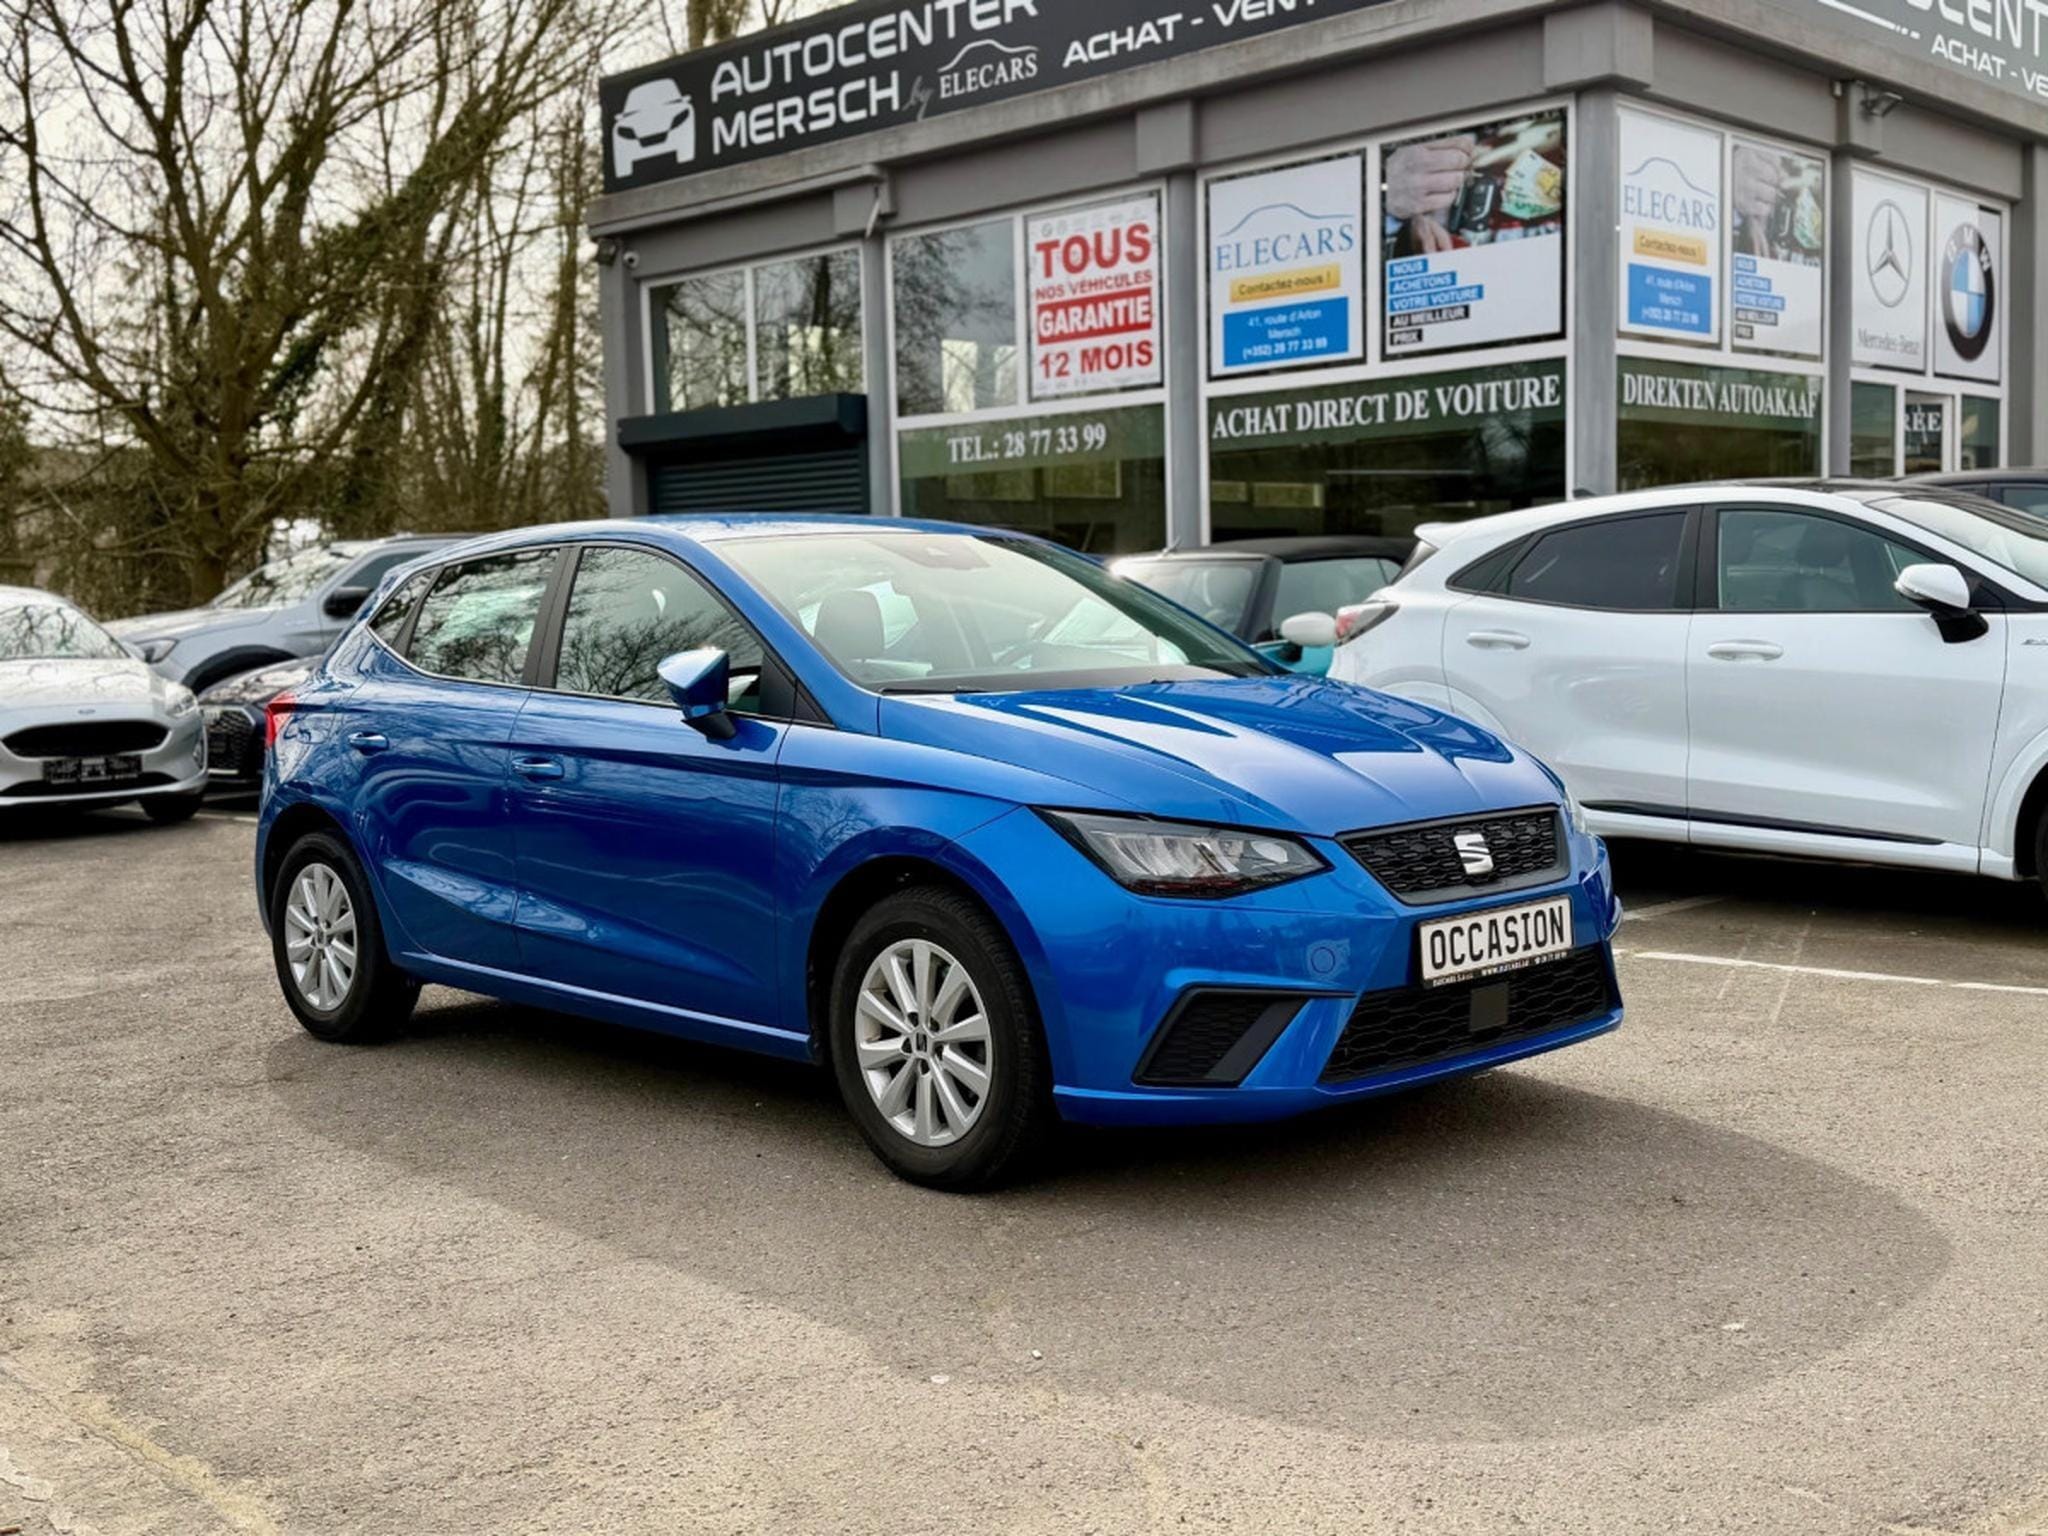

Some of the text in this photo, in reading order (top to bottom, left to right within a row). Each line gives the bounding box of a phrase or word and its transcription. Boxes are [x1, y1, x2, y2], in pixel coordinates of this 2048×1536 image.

[711, 0, 1039, 102] AUTOCENTER
[1063, 13, 1183, 68] ACHAT
[1211, 0, 1314, 27] VEN
[1906, 0, 2048, 57] CENT
[1931, 34, 2006, 79] ACHAT
[713, 71, 900, 155] MERSCH
[940, 53, 1038, 99] ELECARS
[1624, 185, 1716, 231] ELECARS
[1035, 223, 1152, 279] TOUS
[1216, 224, 1354, 271] ELECARS
[1035, 286, 1065, 299] NOS
[1238, 274, 1323, 295] Contactez-nous
[1039, 295, 1150, 338] GARANTIE
[1040, 340, 1153, 378] 12 MOIS
[1212, 375, 1561, 439] ACHAT DIRECT DE VOITURE
[1623, 373, 1819, 418] DIREKTEN AUTOAKAAF
[1004, 432, 1025, 458] 28
[1029, 429, 1051, 455] 77
[1056, 426, 1078, 453] 33
[1083, 423, 1106, 450] 99
[1430, 906, 1564, 970] OCCASION
